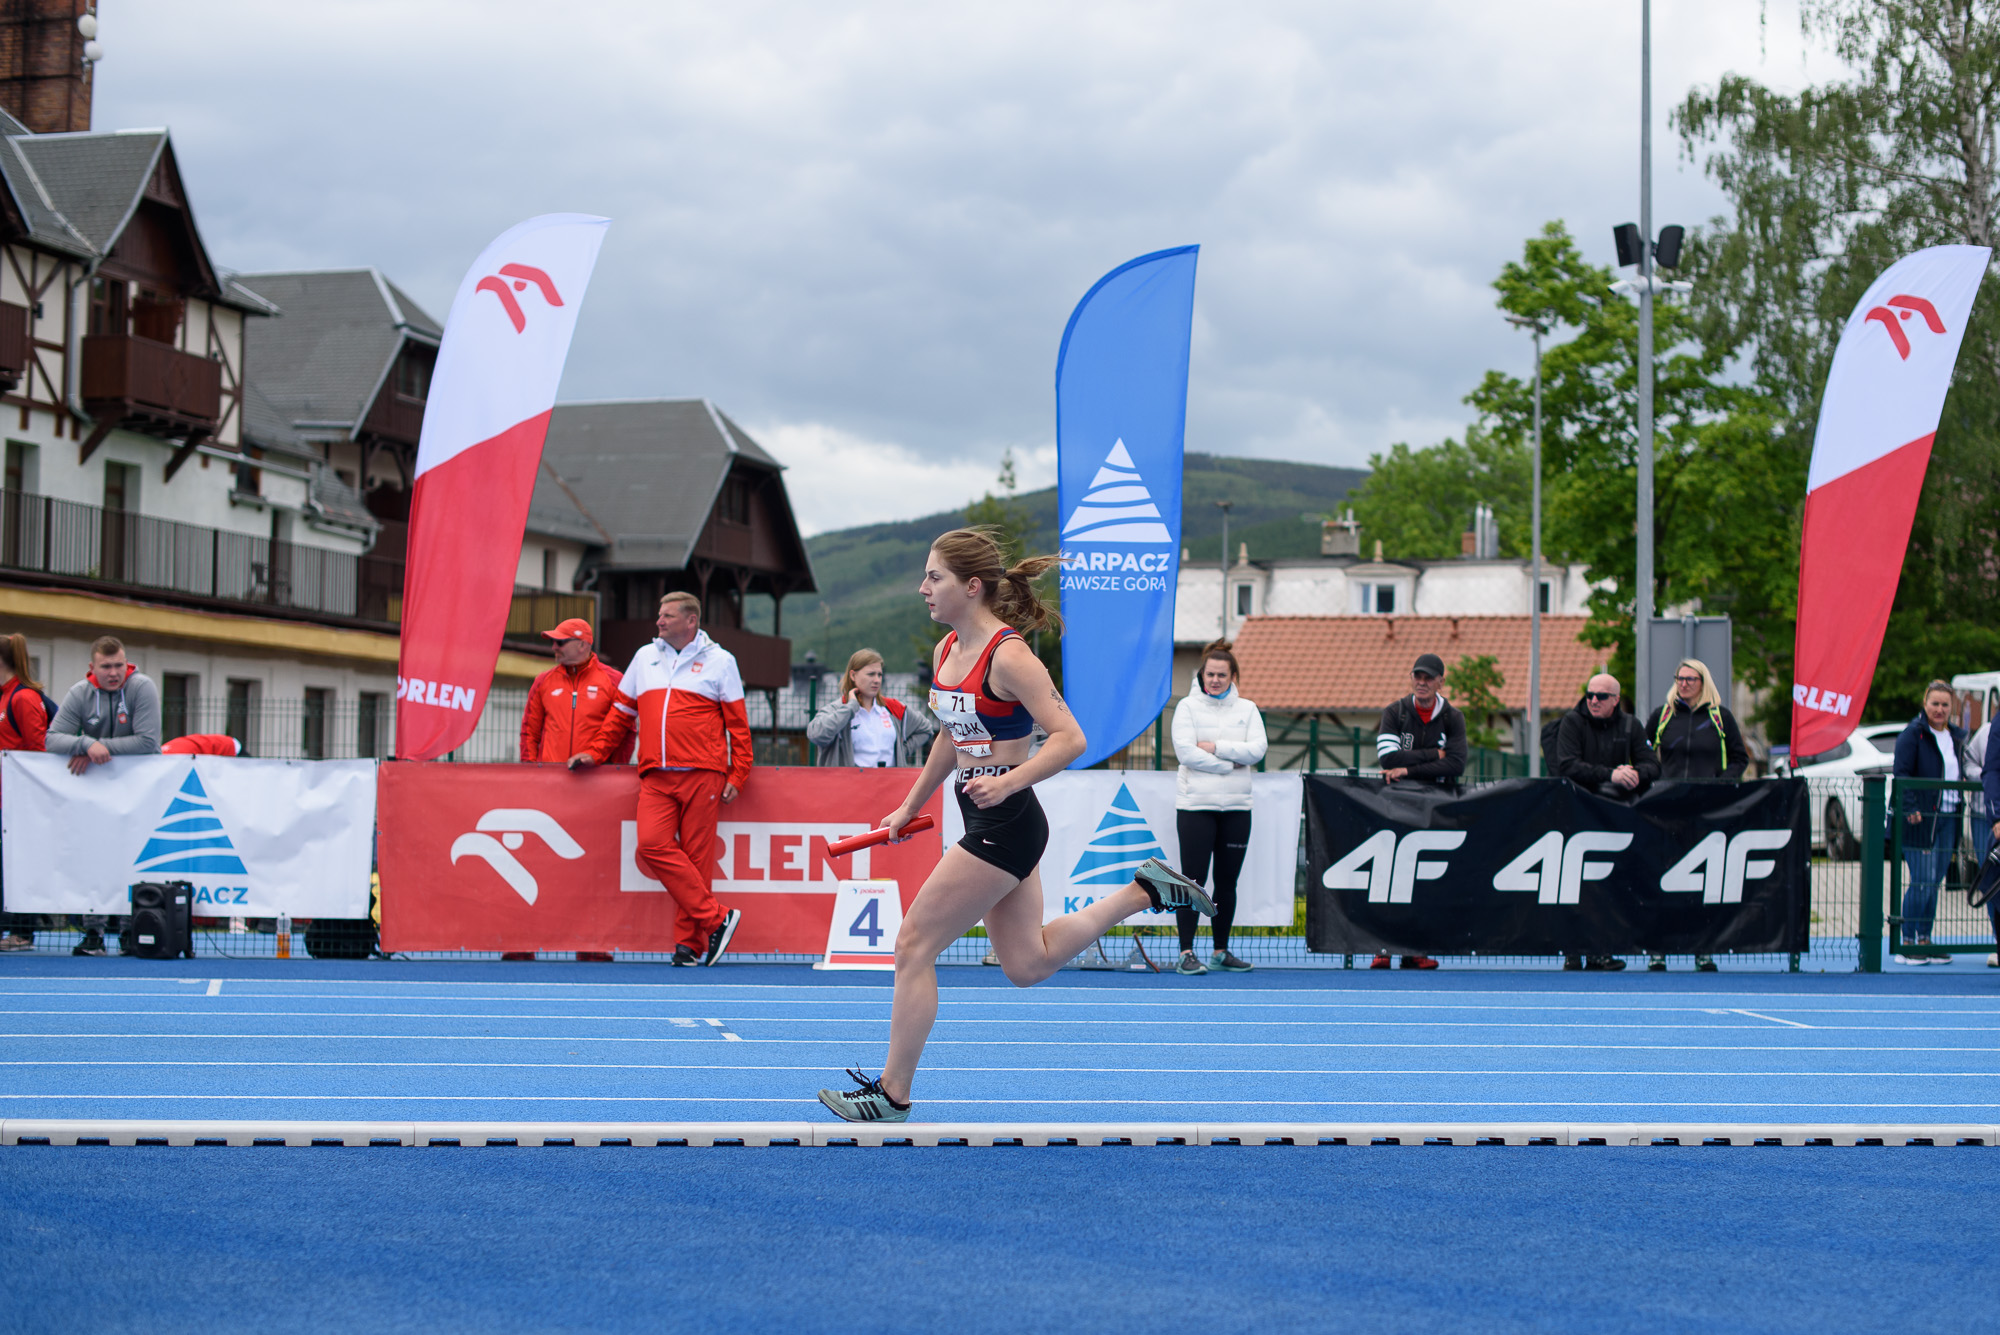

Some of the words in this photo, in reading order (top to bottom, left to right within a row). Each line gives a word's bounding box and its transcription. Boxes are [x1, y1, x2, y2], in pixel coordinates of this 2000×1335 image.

[1060, 552, 1171, 572] KARPACZ
[1124, 574, 1167, 592] GÓRĄ
[952, 696, 966, 712] 71
[1793, 683, 1853, 717] RLEN
[1322, 829, 1467, 903] 4F
[1492, 830, 1634, 904] 4F
[1660, 829, 1792, 904] 4F
[849, 898, 884, 946] 4
